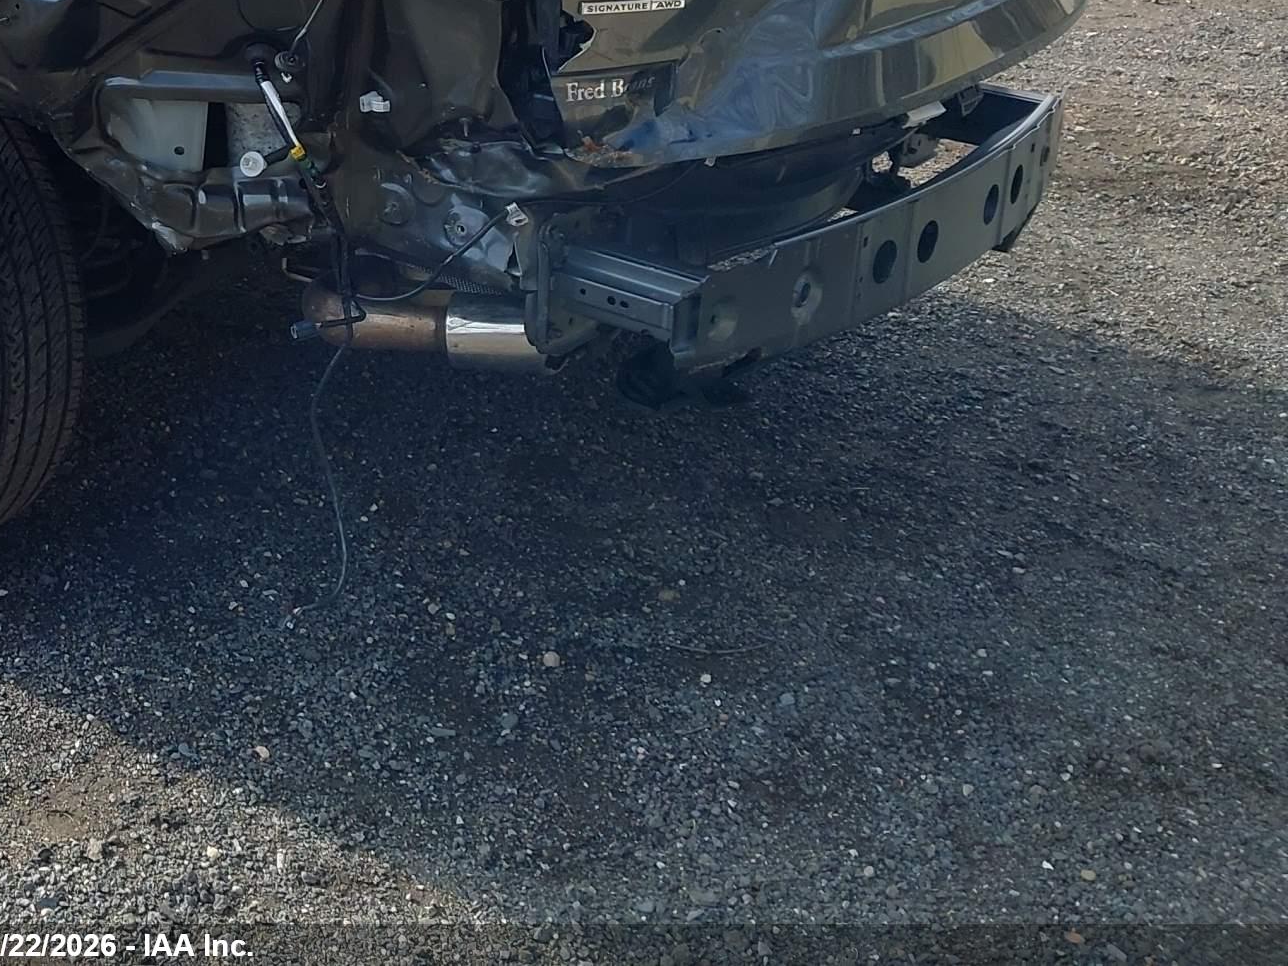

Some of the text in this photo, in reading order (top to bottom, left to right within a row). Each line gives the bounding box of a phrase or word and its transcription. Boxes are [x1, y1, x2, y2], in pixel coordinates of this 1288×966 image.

[586, 0, 682, 13] SIGNATURE AWD
[566, 79, 605, 102] Fred
